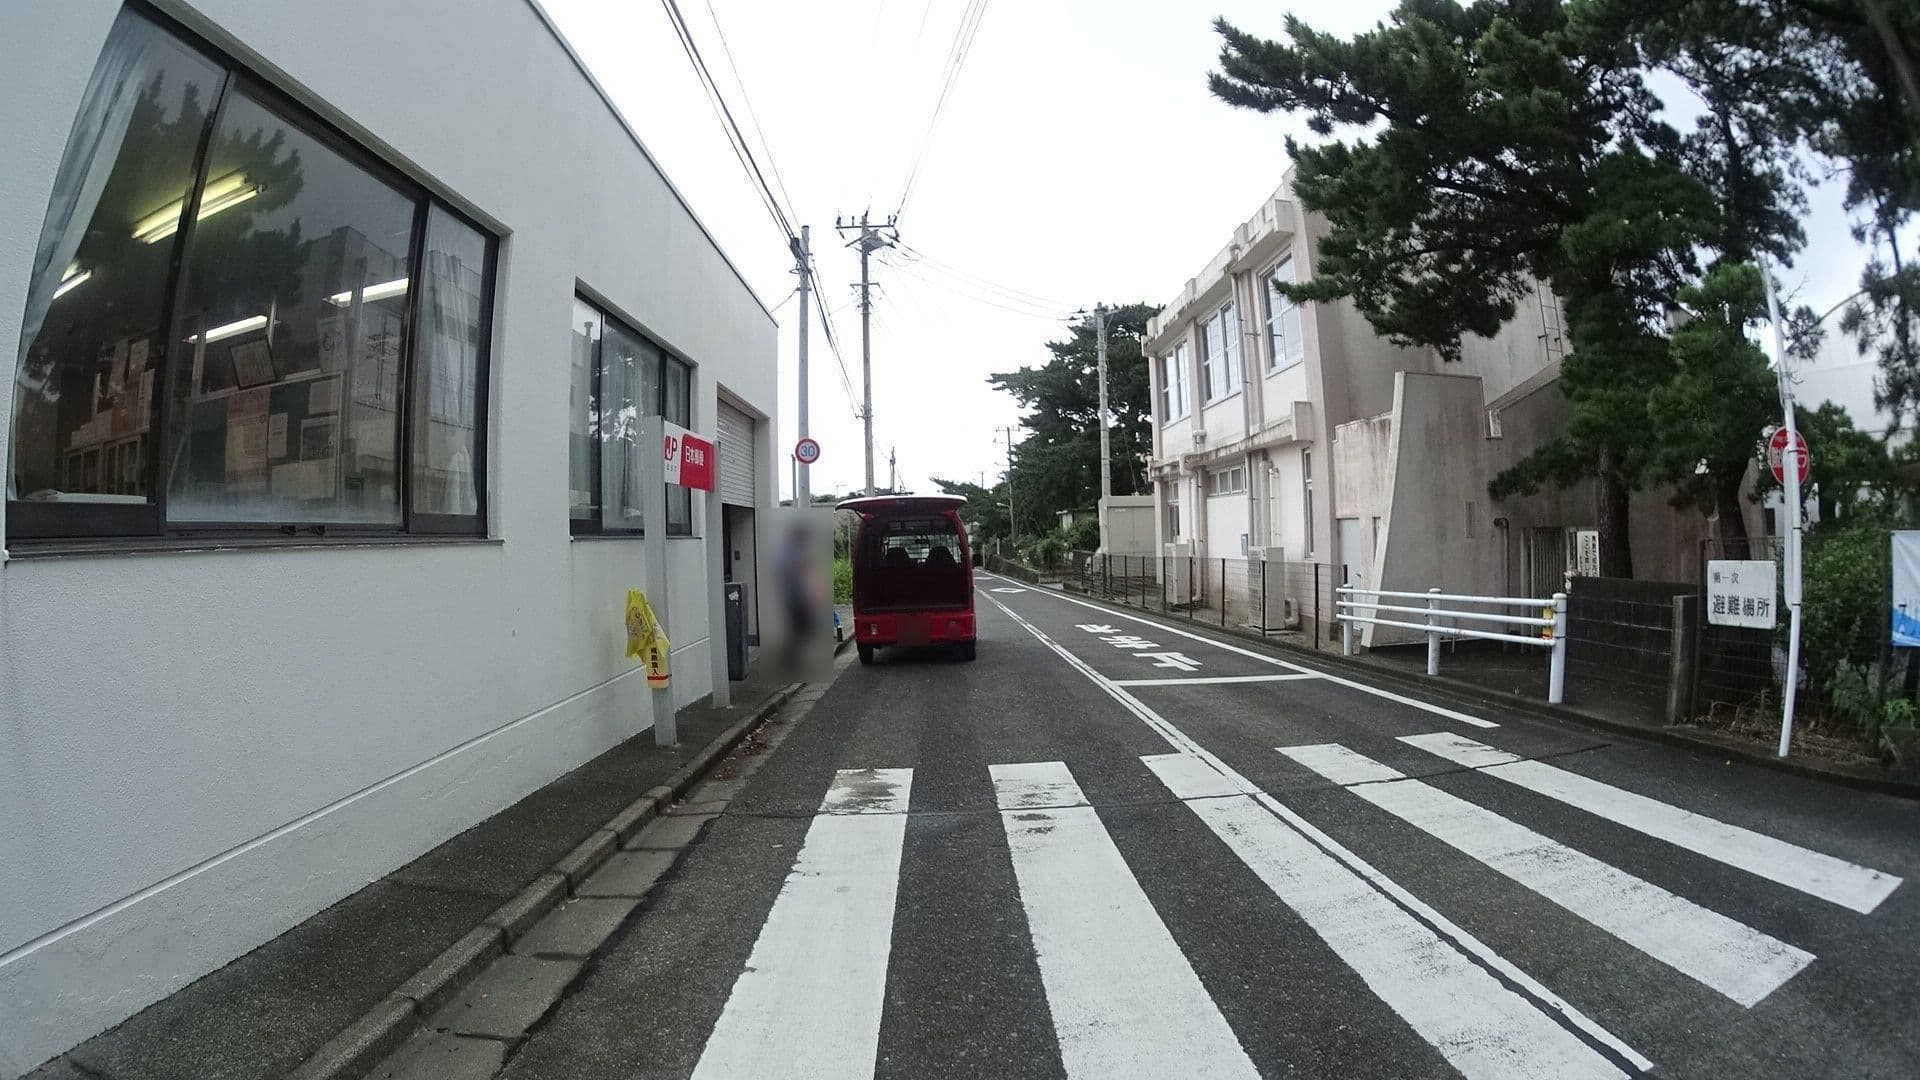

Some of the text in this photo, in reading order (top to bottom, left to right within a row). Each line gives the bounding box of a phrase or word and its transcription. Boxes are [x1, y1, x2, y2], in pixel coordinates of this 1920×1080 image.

[801, 445, 815, 457] 30
[1713, 572, 1739, 584] 第一次
[1713, 594, 1770, 618] 避難場所
